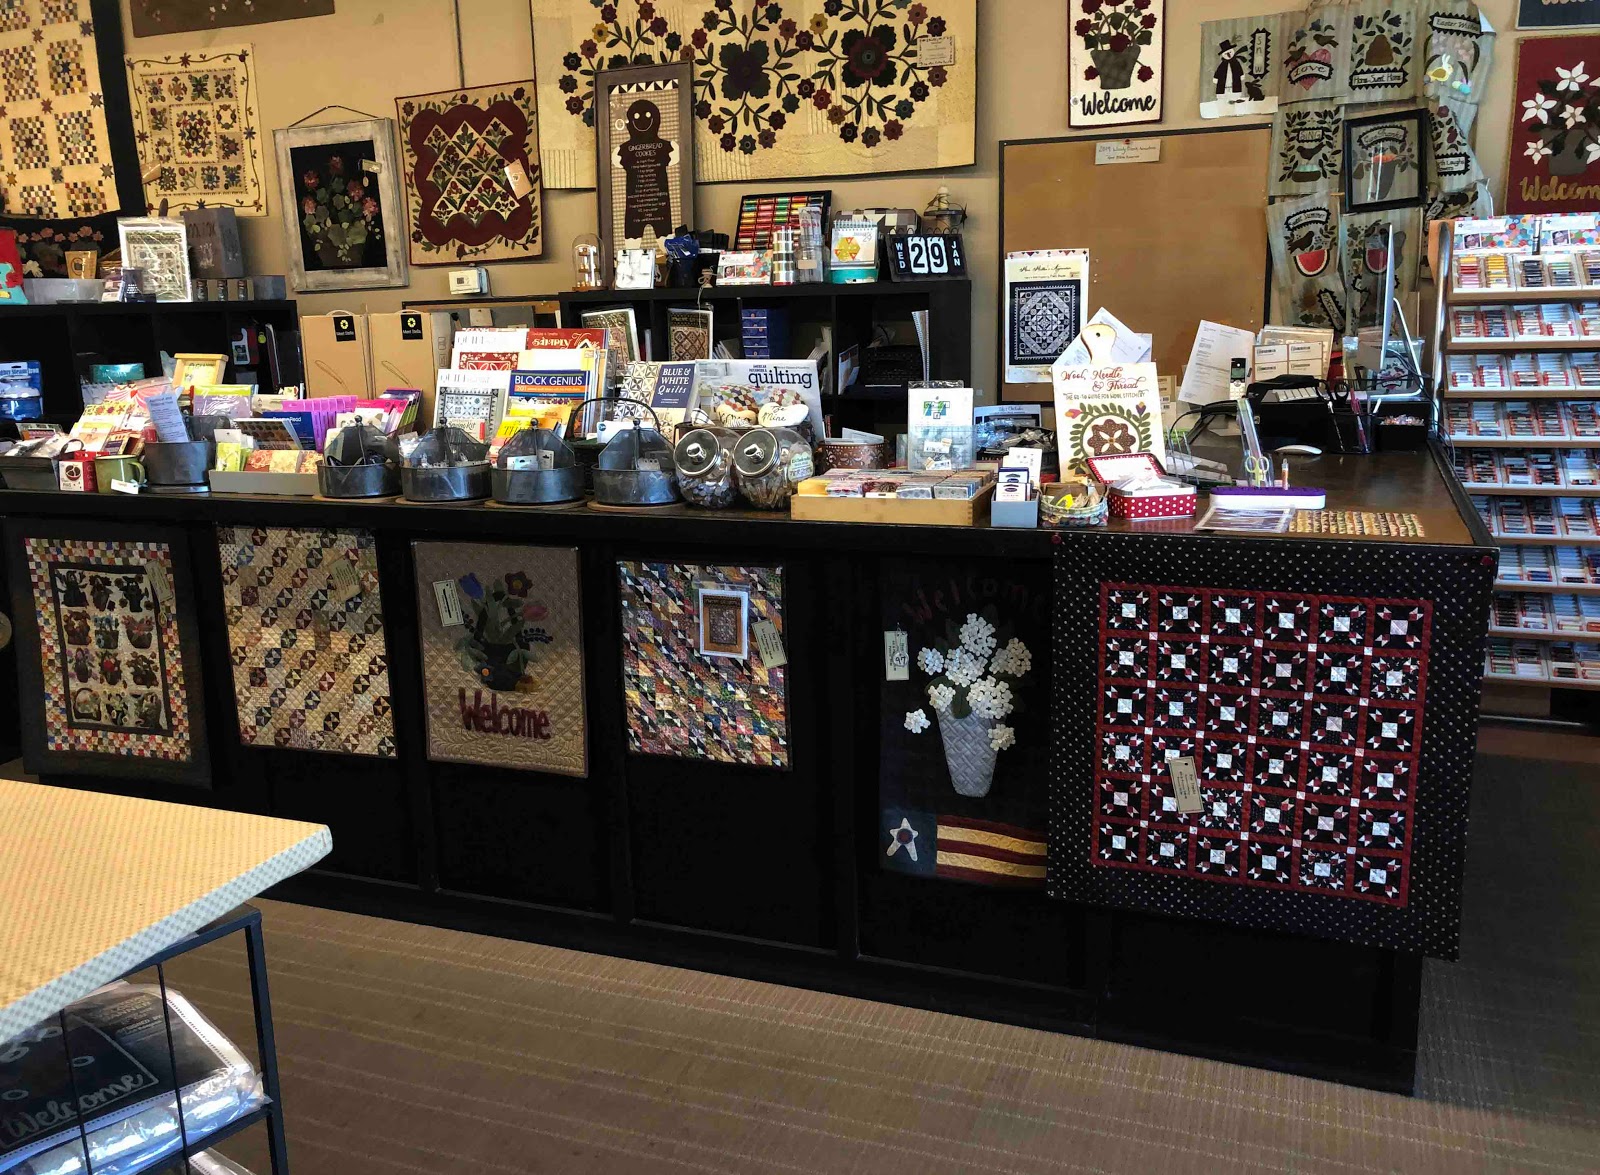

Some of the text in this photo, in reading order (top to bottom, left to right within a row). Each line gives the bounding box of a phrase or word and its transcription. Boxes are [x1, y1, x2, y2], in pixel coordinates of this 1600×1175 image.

[1080, 91, 1156, 116] Welcome
[628, 143, 663, 152] GINGERBREAD
[635, 150, 657, 158] COOKIES
[1520, 175, 1600, 202] Welcom
[895, 242, 906, 269] WED
[951, 240, 961, 266] JAN
[662, 368, 684, 376] BLUE
[684, 368, 692, 376] &
[748, 366, 813, 389] quilting
[1061, 366, 1123, 381] Wool, Needle
[514, 375, 583, 386] BLOCK GENIUS
[661, 376, 690, 385] WHITE
[1092, 376, 1147, 392] & Thread
[657, 385, 687, 395] Quilts
[458, 686, 552, 740] Welcome
[1, 1073, 144, 1138] Welcome
